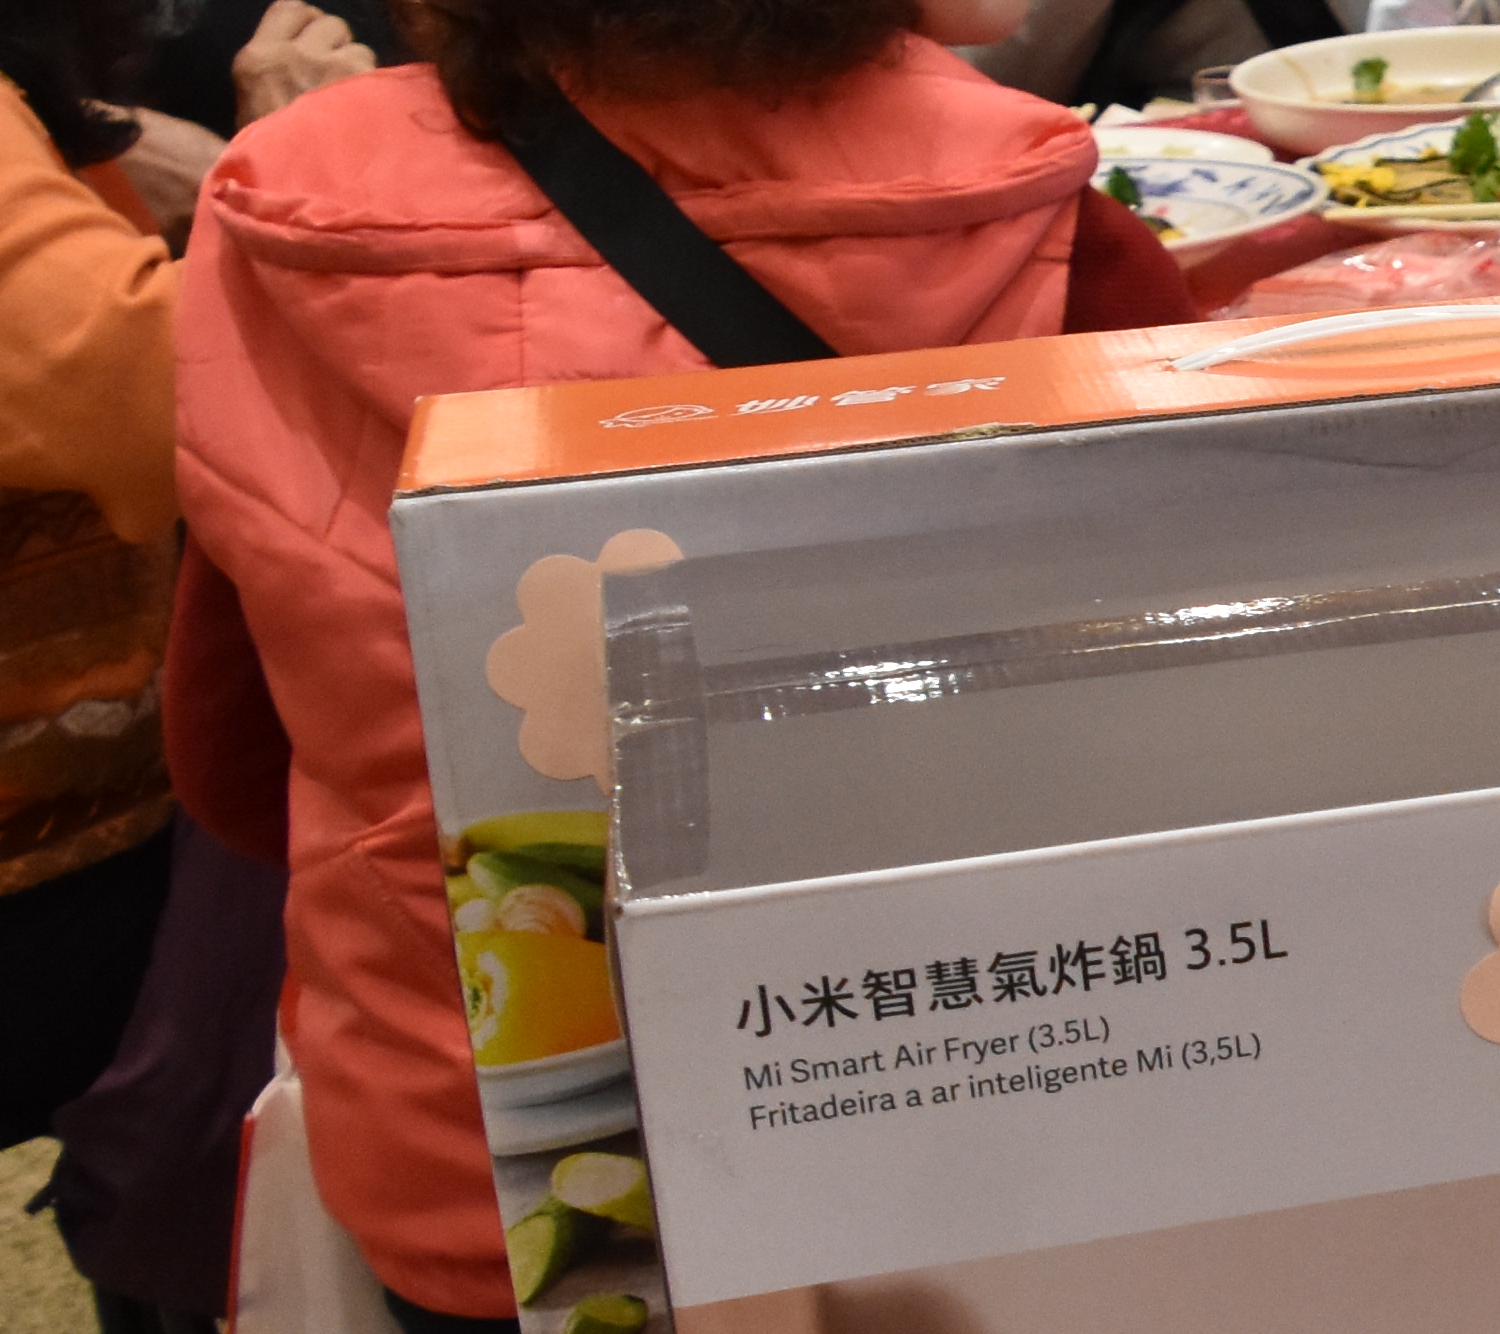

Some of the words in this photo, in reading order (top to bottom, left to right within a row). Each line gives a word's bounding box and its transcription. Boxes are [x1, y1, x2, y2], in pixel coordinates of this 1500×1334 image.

[737, 933, 1166, 1038] 小米智慧氣炸鍋
[1185, 920, 1288, 971] 3.5L
[744, 1062, 782, 1091] Mi
[791, 1047, 885, 1084] Smart
[894, 1039, 937, 1070] Air
[943, 1027, 1020, 1070] Fryer
[1027, 1017, 1110, 1054] (3.5L)
[749, 1087, 896, 1131] Fritadeira
[905, 1086, 924, 1107] a
[932, 1080, 961, 1104] ar
[969, 1052, 1128, 1099] inteligente
[1137, 1043, 1174, 1073] Mi
[1181, 1033, 1263, 1069] (3,5L)
